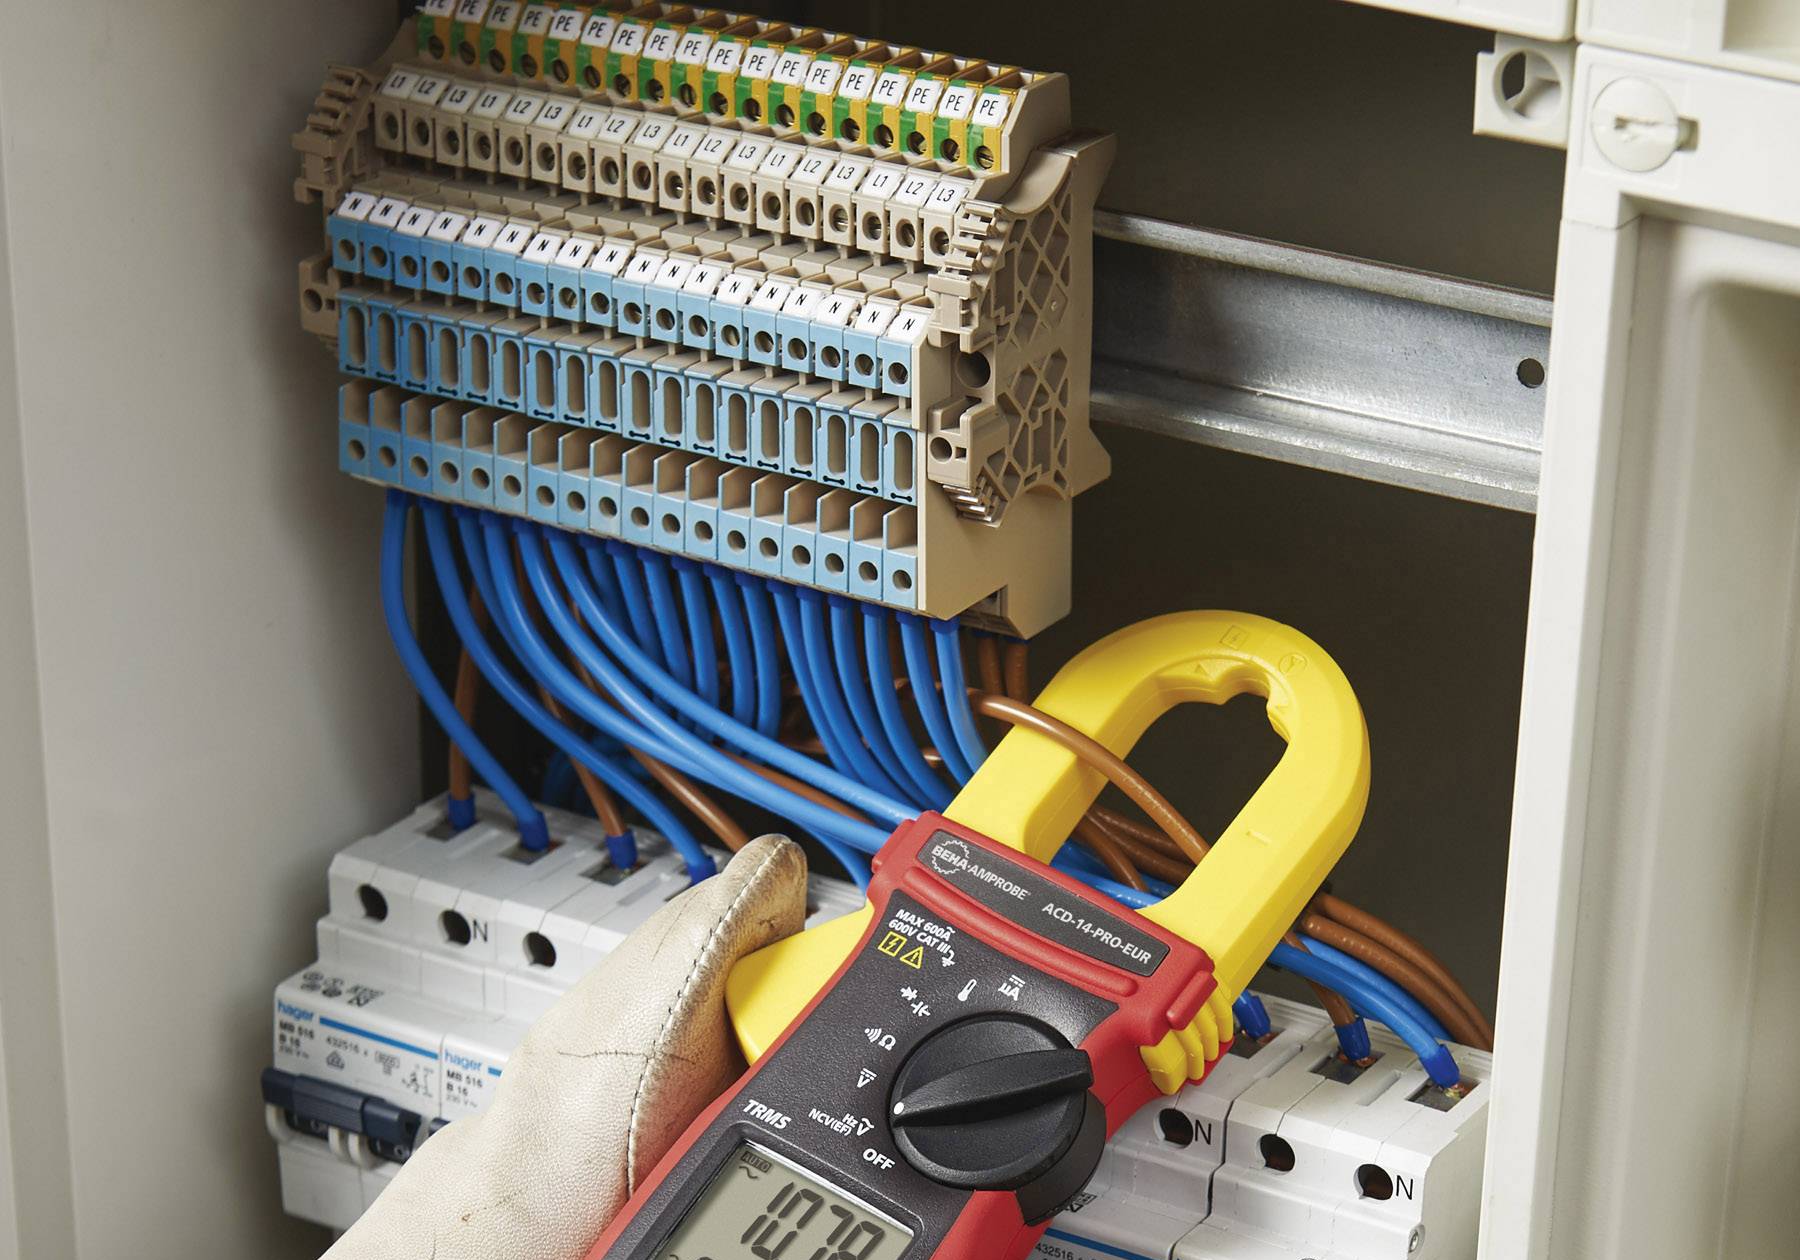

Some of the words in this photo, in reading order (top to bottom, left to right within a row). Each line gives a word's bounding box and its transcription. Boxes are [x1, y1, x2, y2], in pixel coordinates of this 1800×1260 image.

[461, 0, 479, 15] PE
[492, 5, 509, 22] PE
[524, 11, 542, 27] PE
[556, 15, 574, 31] PE
[588, 21, 606, 38] PE
[618, 30, 635, 46] PE
[651, 35, 668, 51] PE
[684, 40, 701, 56] PE
[715, 49, 732, 64] PE
[748, 55, 766, 71] PE
[781, 60, 799, 77] PE
[390, 75, 406, 88] L1
[812, 68, 830, 84] PE
[847, 74, 864, 90] PE
[418, 80, 436, 94] L2
[879, 80, 897, 96] PE
[449, 89, 467, 103] L3
[481, 95, 497, 107] L1
[912, 88, 930, 104] PE
[513, 100, 531, 113] L2
[946, 95, 964, 111] PE
[980, 100, 998, 116] PE
[544, 106, 562, 119] L3
[578, 115, 593, 127] L1
[607, 120, 624, 133] L2
[643, 125, 661, 138] L3
[674, 134, 689, 146] L1
[704, 139, 722, 152] L2
[739, 146, 756, 159] L3
[770, 154, 785, 166] L1
[803, 160, 821, 173] L2
[837, 166, 854, 179] L3
[873, 175, 888, 187] L1
[906, 181, 923, 195] L2
[937, 189, 954, 202] L3
[349, 198, 361, 210] N
[380, 205, 392, 216] N
[408, 214, 420, 225] N
[440, 218, 452, 229] N
[475, 225, 486, 236] N
[507, 231, 518, 242] N
[538, 240, 549, 251] N
[570, 245, 581, 256] N
[606, 251, 617, 262] N
[639, 261, 649, 272] N
[669, 266, 680, 277] N
[696, 272, 707, 282] N
[730, 282, 740, 294] N
[767, 288, 778, 298] N
[796, 294, 807, 305] N
[829, 302, 841, 313] N
[868, 311, 879, 323] N
[903, 319, 915, 330] N
[895, 909, 924, 928] MAX
[473, 920, 487, 942] N
[889, 919, 917, 937] 600V
[916, 932, 939, 949] CAT
[937, 942, 951, 954] III
[1042, 903, 1152, 965] ACD-14-PRO-EUR
[878, 1035, 896, 1051] Ω
[743, 1100, 792, 1129] TRMS
[842, 1113, 858, 1128] Hz
[808, 1108, 853, 1136] NCV(EF)
[1195, 1120, 1211, 1145] N
[743, 1153, 770, 1172] AUTO
[862, 1148, 895, 1170] OFF
[1396, 1175, 1413, 1200] N
